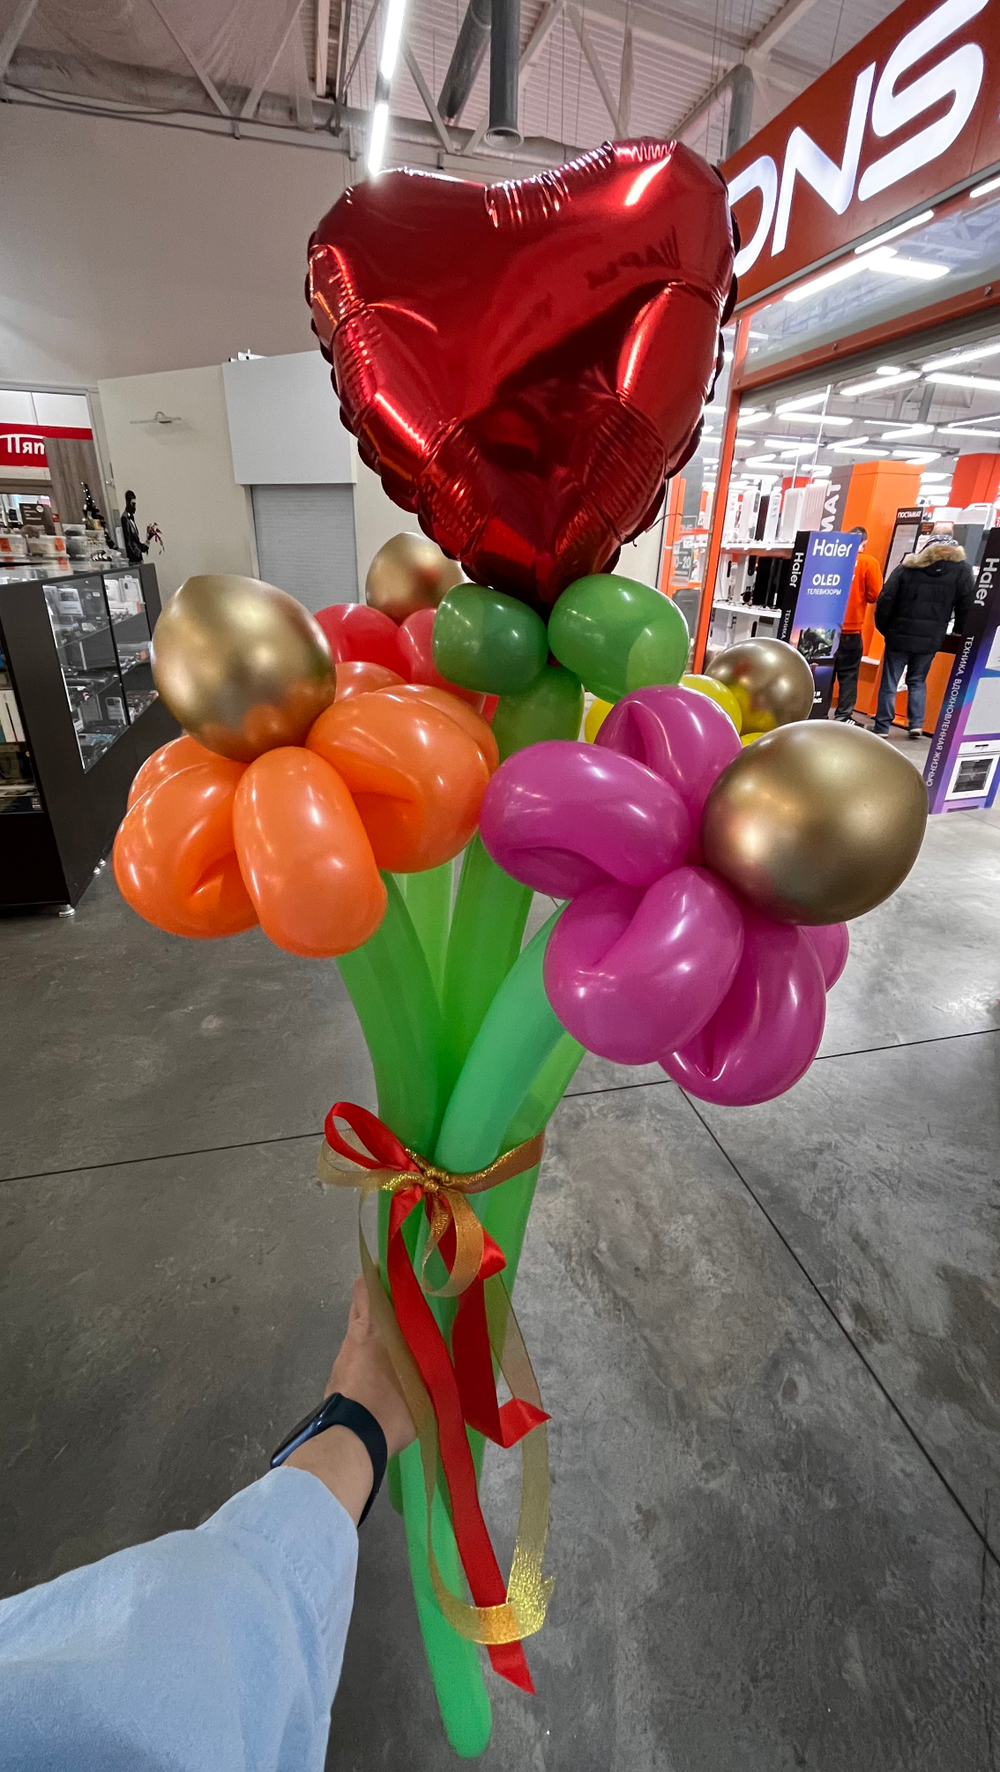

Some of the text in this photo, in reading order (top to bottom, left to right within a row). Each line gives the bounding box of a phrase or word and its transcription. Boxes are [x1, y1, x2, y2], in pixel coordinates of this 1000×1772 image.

[727, 0, 989, 278] DNS
[812, 538, 853, 557] Haier
[789, 552, 804, 588] Haier
[812, 573, 840, 586] OLED
[973, 557, 1000, 607] Haier
[807, 588, 842, 596] ТЕЛЕВИЗОРЫ
[926, 636, 975, 787] ТЕХНИКА, ВДОХНОВЛЕННАЯ ЖИЗНЬЮ
